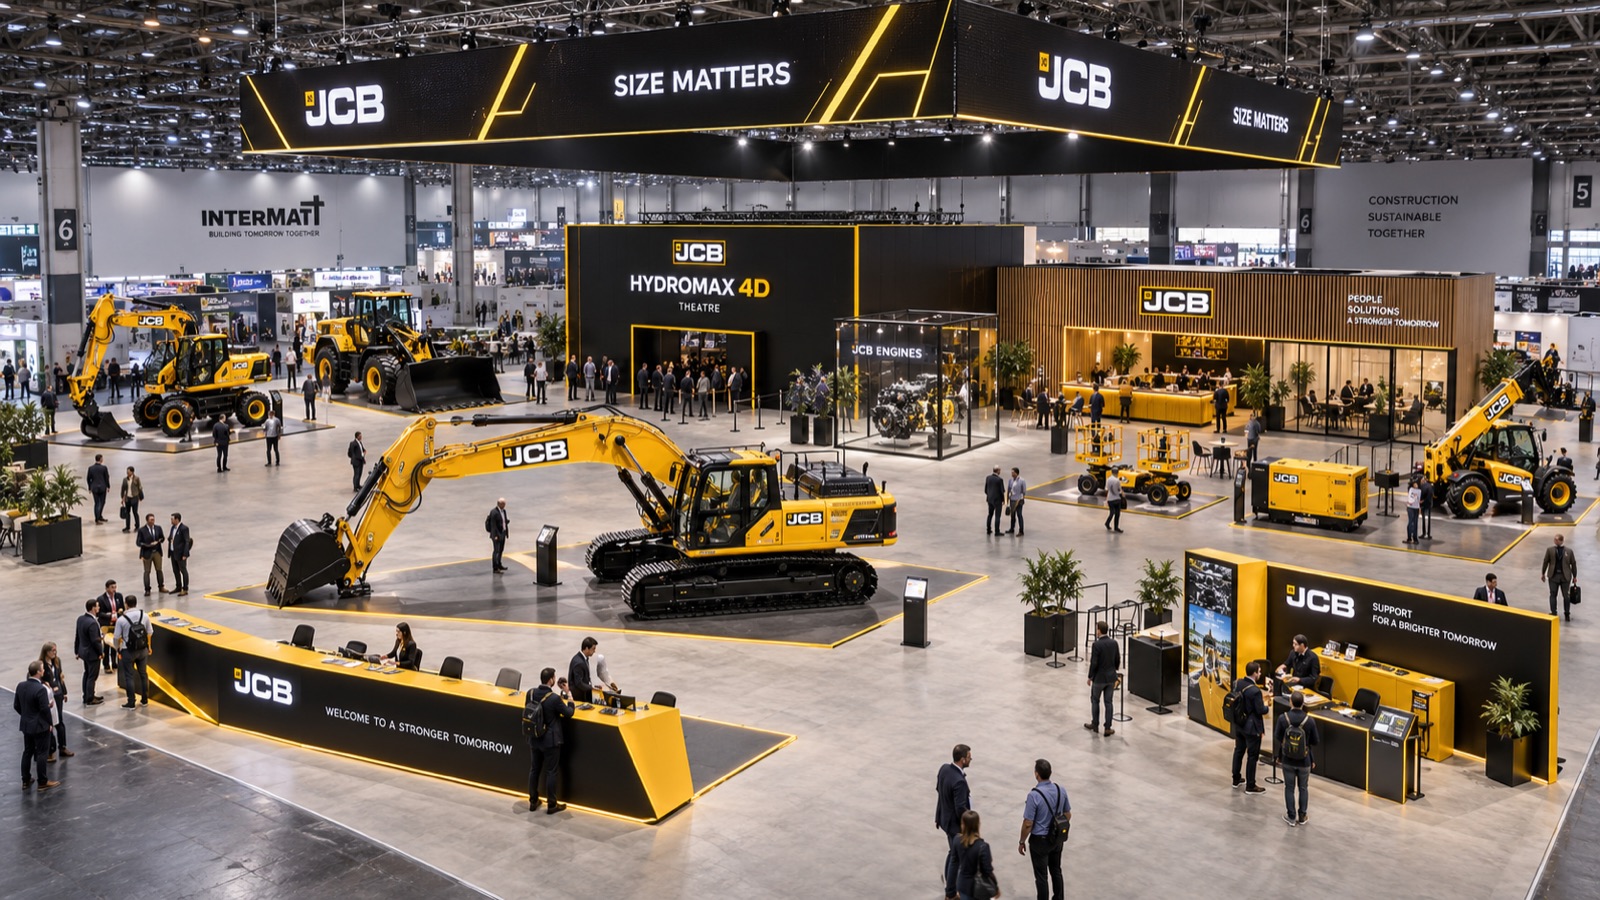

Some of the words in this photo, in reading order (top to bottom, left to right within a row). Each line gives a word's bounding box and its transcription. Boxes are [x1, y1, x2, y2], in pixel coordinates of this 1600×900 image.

[614, 72, 664, 97] SIZE
[673, 61, 791, 93] MATTERS
[1038, 55, 1112, 110] JCB
[305, 84, 385, 127] JCB
[1232, 106, 1253, 127] SIZE
[1253, 110, 1289, 134] MATTERS
[1576, 182, 1589, 200] 5
[1368, 195, 1459, 206] CONSTRUCTION
[1301, 214, 1310, 229] 6
[1368, 212, 1442, 222] SUSTAINABLE
[58, 218, 74, 241] 6
[208, 230, 242, 238] BUILDING
[1368, 228, 1425, 238] TOGETHER
[675, 243, 724, 262] JCB
[630, 274, 736, 297] HYDROMAX
[738, 278, 771, 298] 4D
[678, 301, 721, 314] THEATRE
[1143, 291, 1210, 314] JCB
[1347, 294, 1383, 304] PEOPLE
[1347, 305, 1400, 316] SOLUTIONS
[138, 316, 164, 326] JCB
[1347, 317, 1353, 325] A
[851, 345, 873, 356] JCB
[876, 346, 922, 359] ENGINES
[232, 361, 249, 370] JCB
[1486, 394, 1510, 420] JCB
[504, 440, 567, 467] JCB
[1274, 474, 1298, 484] JCB
[1499, 473, 1522, 485] JCB
[787, 513, 823, 525] JCB
[1286, 586, 1355, 618] JCB
[1372, 602, 1413, 619] SUPPORT
[1372, 614, 1390, 626] FOR
[1390, 619, 1398, 628] A
[1398, 620, 1441, 638] BRIGHTER
[1442, 630, 1498, 651] TOMORROW
[234, 670, 293, 706] JCB
[325, 706, 370, 725] WELCOME
[373, 716, 387, 728] TO
[389, 720, 396, 731] A
[398, 722, 450, 742] STRONGER
[453, 733, 513, 755] TOMORROW
